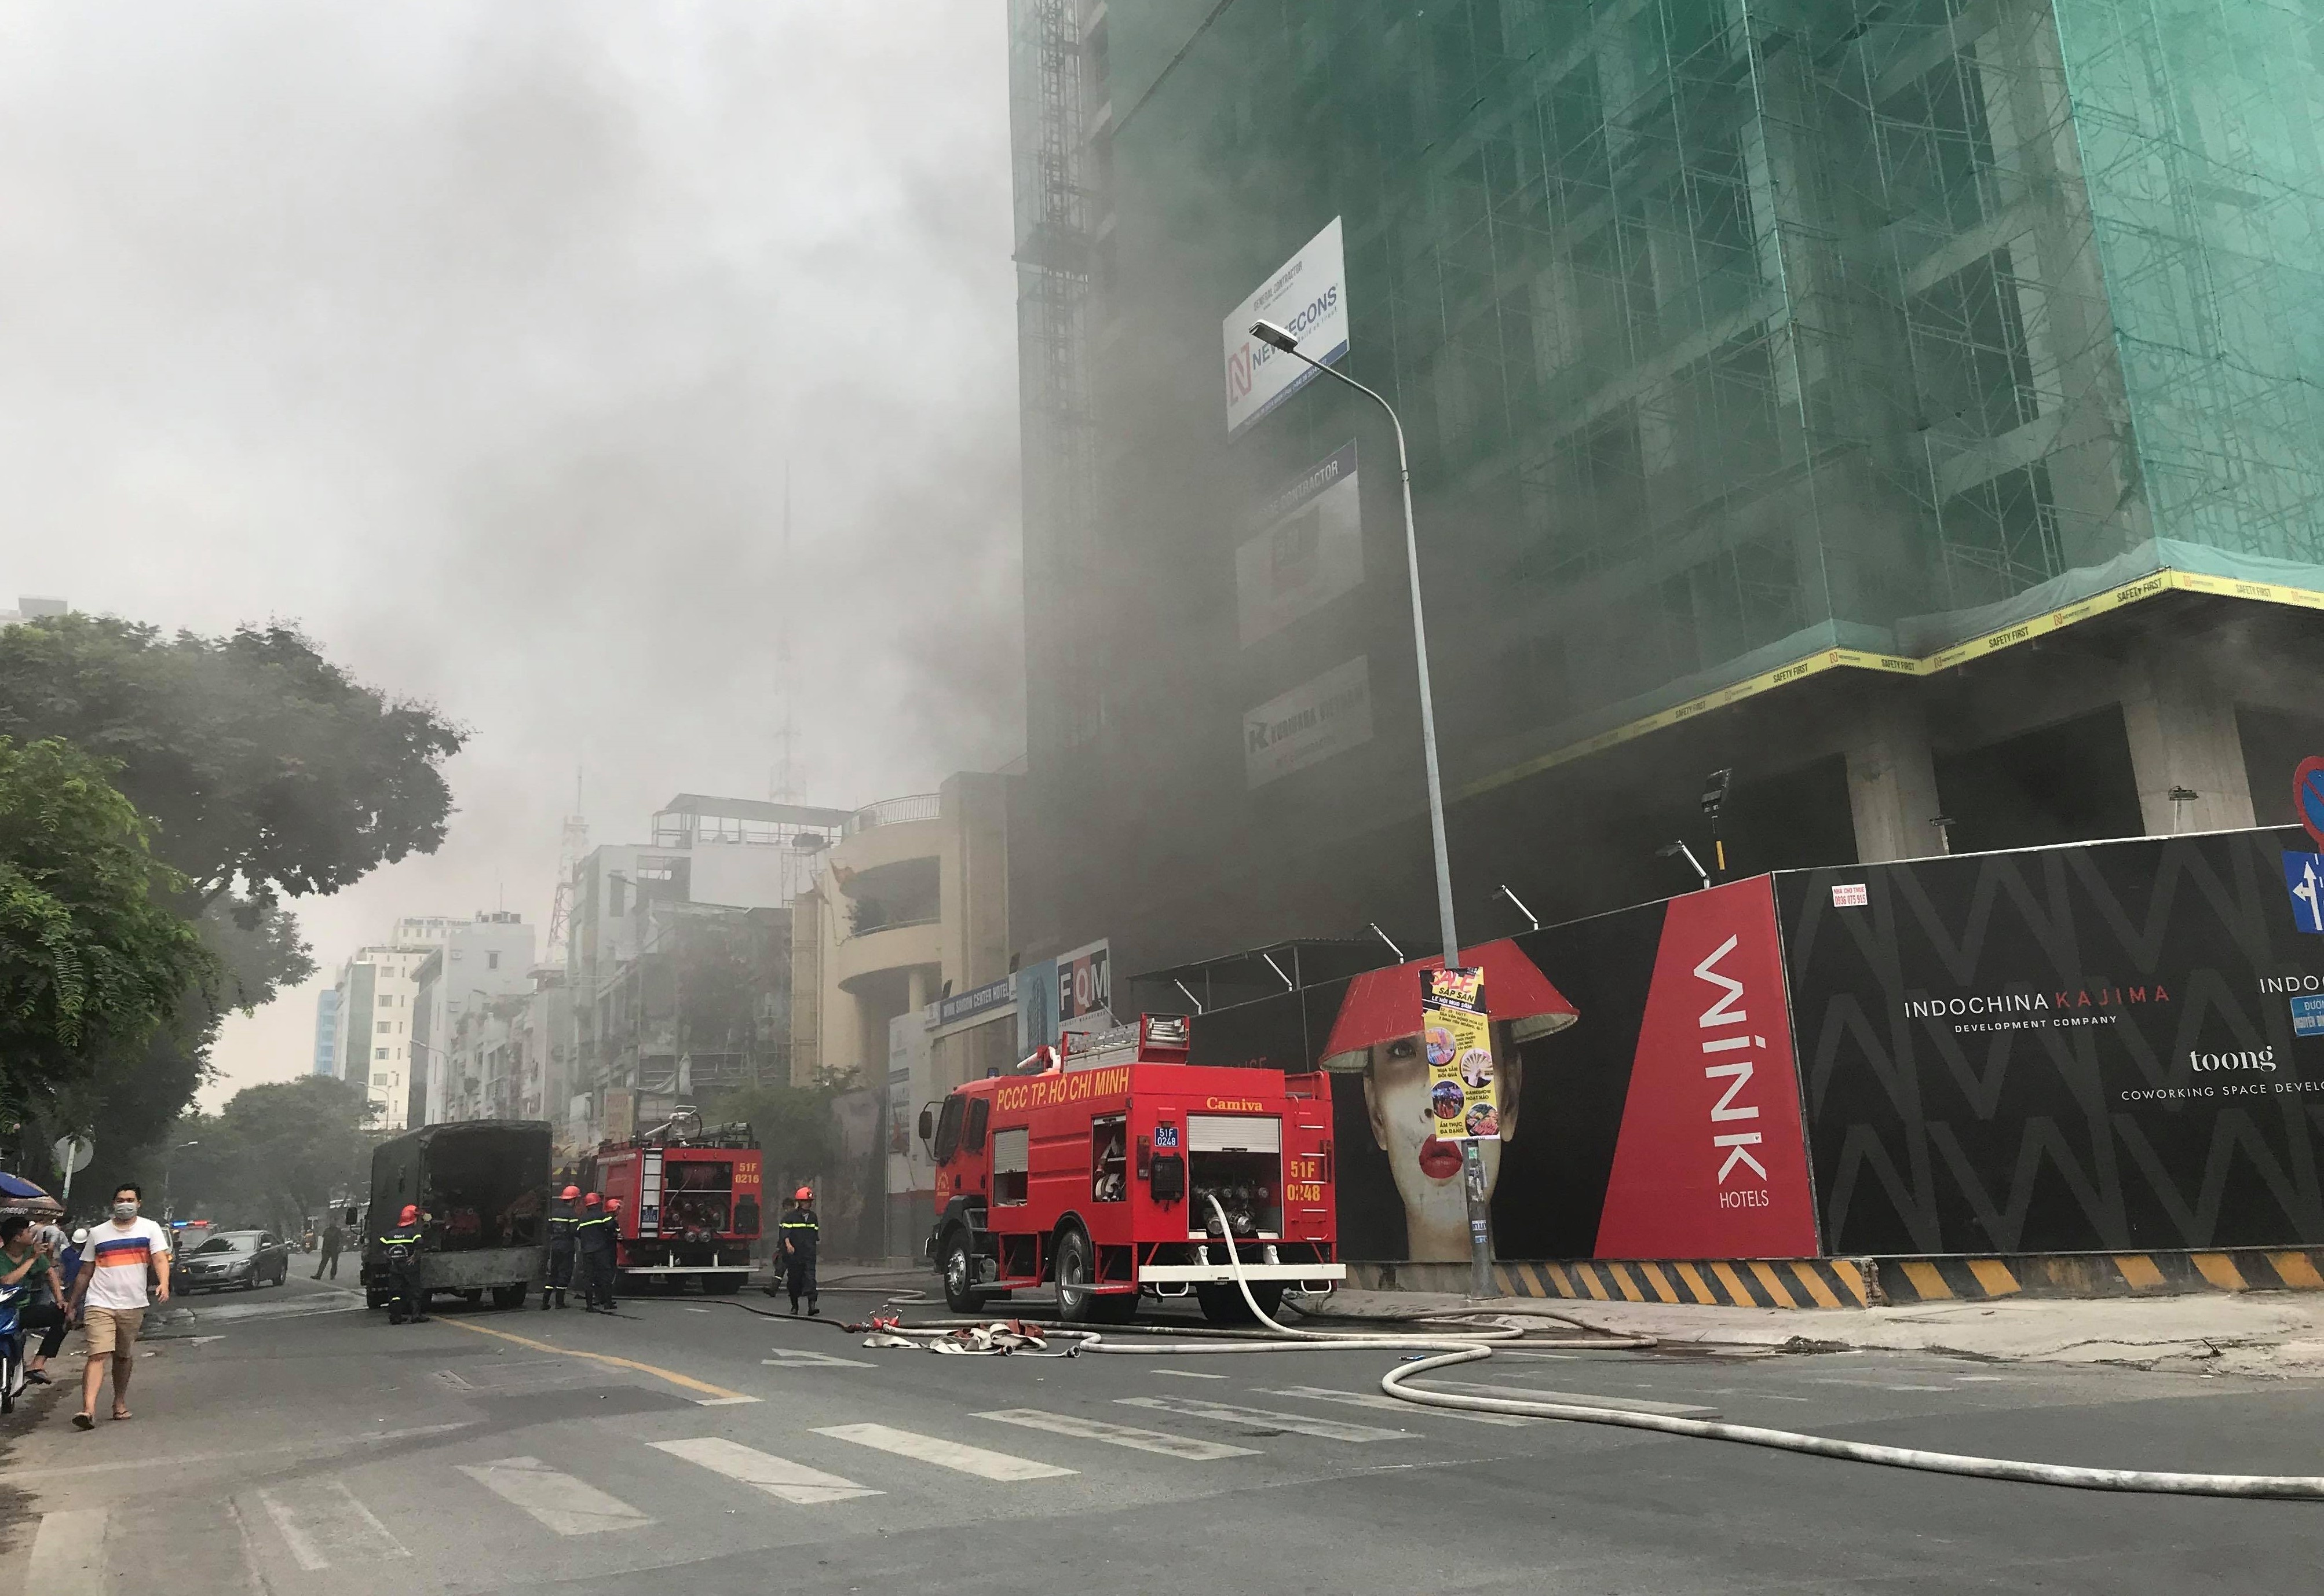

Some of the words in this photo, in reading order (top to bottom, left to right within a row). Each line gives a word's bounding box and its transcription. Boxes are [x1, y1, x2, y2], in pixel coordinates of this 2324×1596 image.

[1273, 261, 1303, 293] CONTRACTOR
[1280, 460, 1339, 505] CONTRACTOR
[2143, 578, 2162, 593] FIRST
[2235, 583, 2256, 594] SAFETY
[2256, 586, 2271, 597] FIRST
[1989, 633, 2011, 648] SAFETY
[2012, 626, 2029, 640] FIRST
[1773, 669, 1792, 683] SAFETY
[1793, 663, 1808, 675] FIRST
[1881, 659, 1901, 669] SAFETY
[1901, 661, 1915, 671] FIRST
[1060, 959, 1108, 1011] FQM
[1430, 968, 1475, 993] SALE
[2260, 975, 2324, 994] INDO
[973, 988, 992, 1007] CENTER
[993, 983, 1009, 1000] HOTEL
[1904, 993, 2049, 1018] INDOCHINA
[2055, 984, 2170, 1009] KAJIMA
[1954, 1019, 2047, 1033] DEVELOPMENT
[2053, 1015, 2118, 1027] COMPANY
[2188, 1044, 2277, 1073] toong
[996, 1084, 1028, 1112] PCCC
[1069, 1069, 1093, 1101] CHÍ
[1094, 1067, 1130, 1096] MINH
[2121, 1086, 2215, 1101] COWORKING
[2223, 1083, 2267, 1096] SPACE
[1207, 1097, 1264, 1111] Camiva
[1157, 1137, 1176, 1146] 0248
[1159, 1128, 1174, 1137] 51F
[739, 1162, 758, 1172] 51F
[1291, 1160, 1315, 1178] 51F
[1287, 1184, 1321, 1201] 0248
[1719, 1190, 1770, 1209] HOTELS
